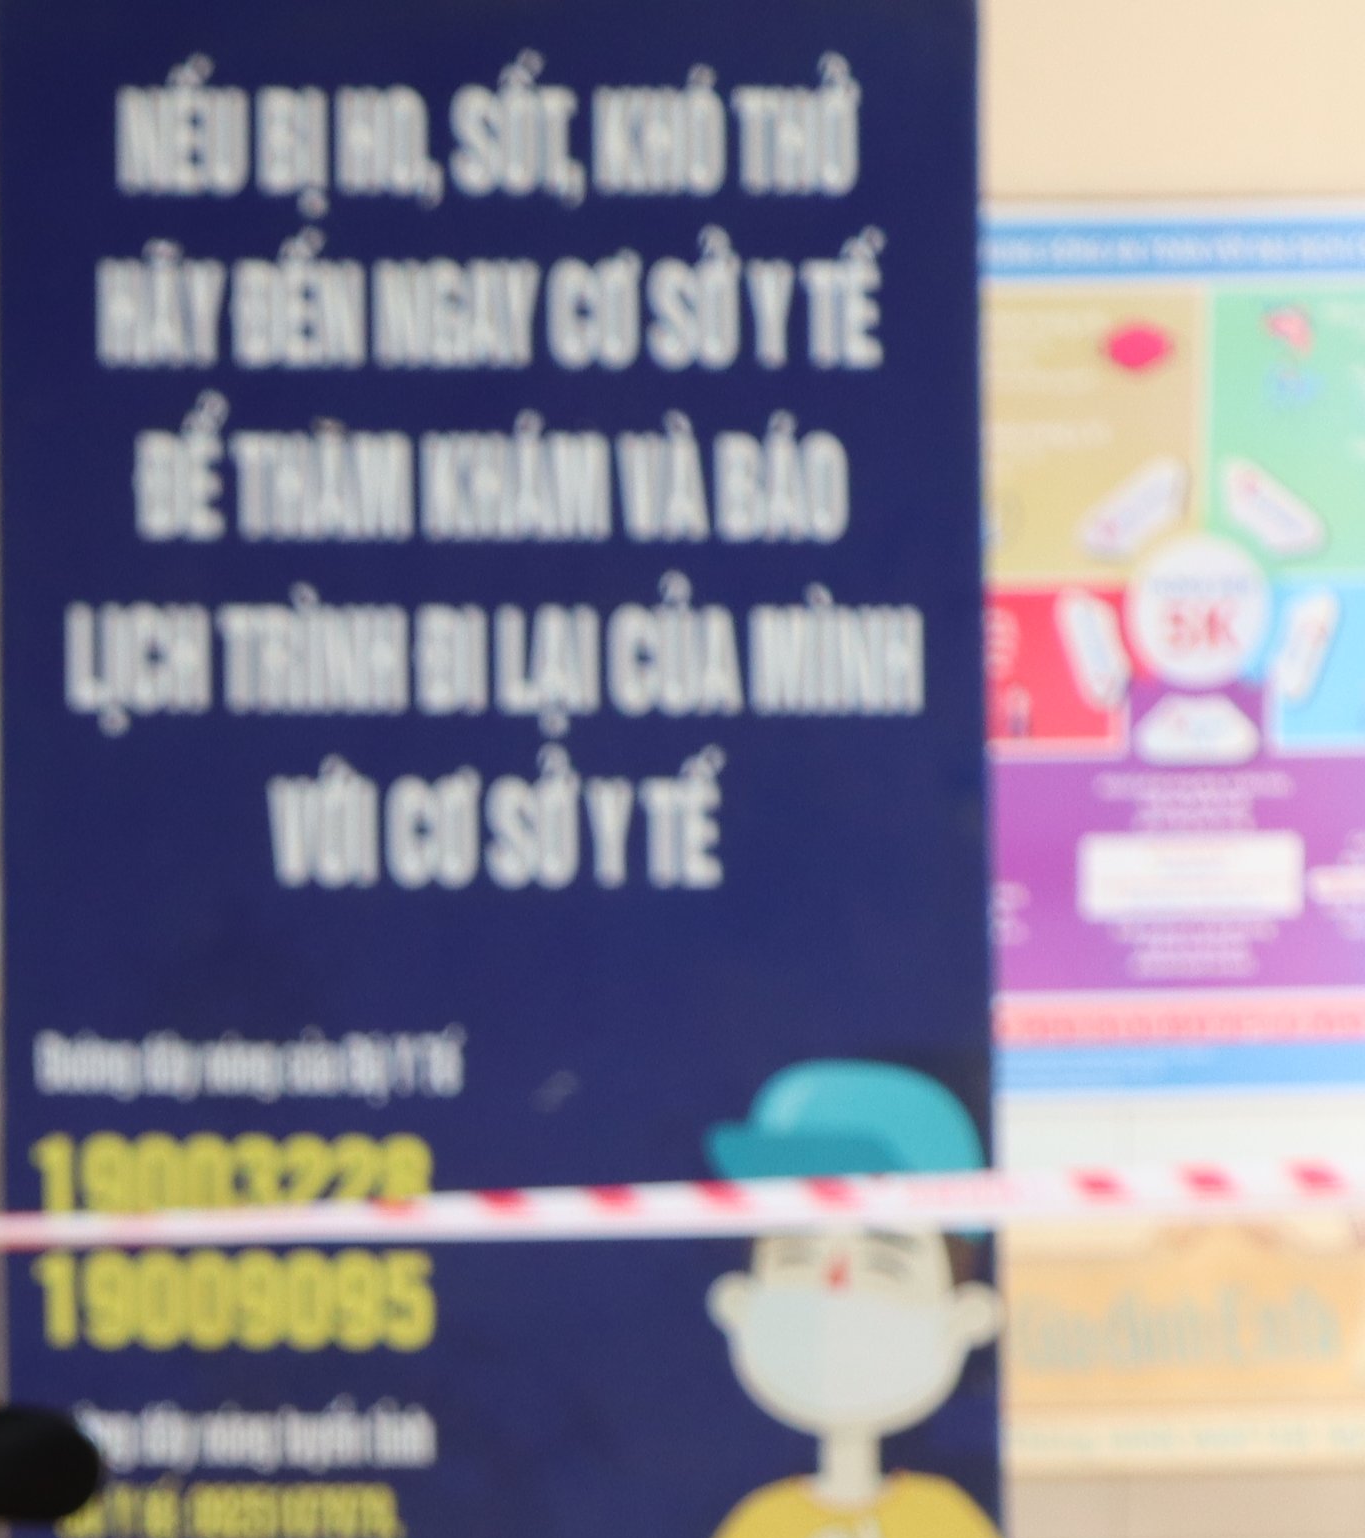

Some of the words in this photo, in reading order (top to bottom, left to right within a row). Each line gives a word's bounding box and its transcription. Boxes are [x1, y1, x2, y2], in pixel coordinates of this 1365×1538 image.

[115, 53, 250, 197] NẾU
[254, 82, 330, 217] BỊ
[451, 49, 586, 209] SỐT,
[592, 66, 725, 197] KHÓ
[732, 51, 861, 197] THỞ
[95, 238, 225, 369] HÃY
[229, 226, 367, 369] ĐẾN
[371, 256, 541, 369] NGAY
[546, 246, 642, 371] CƠ
[648, 224, 741, 371] SỞ
[744, 256, 797, 369] Y
[800, 226, 885, 369] TẾ
[133, 390, 228, 541] ĐỂ
[419, 409, 612, 541] KHÁM
[615, 409, 711, 541] VÀ
[714, 409, 850, 541] BÁO
[66, 600, 213, 737] LỊCH
[217, 581, 410, 714] TRÌNH
[413, 603, 488, 714] ĐI
[494, 603, 600, 738] LẠI
[606, 570, 743, 714] CỦA
[747, 581, 925, 714] MÌNH
[268, 753, 379, 888] VỚI
[385, 767, 482, 888] CƠ
[486, 741, 580, 888] SỞ
[584, 774, 633, 888] Y
[637, 744, 724, 888] TẾ
[31, 1247, 437, 1353] 19009095
